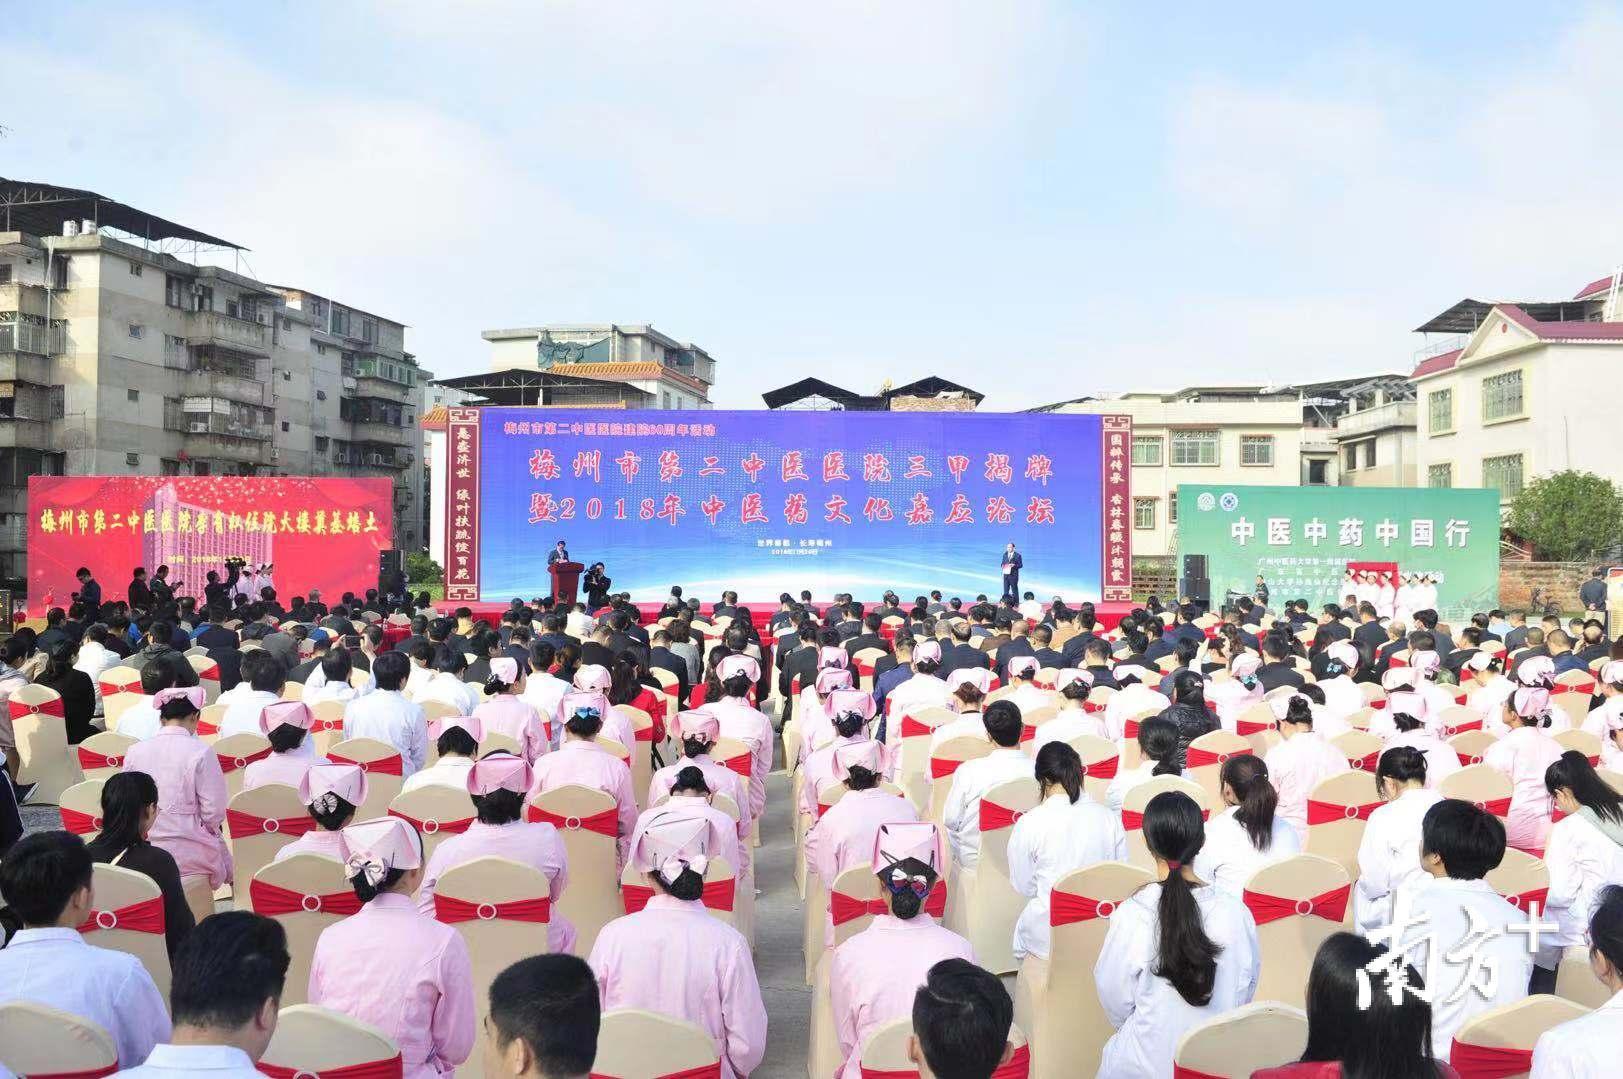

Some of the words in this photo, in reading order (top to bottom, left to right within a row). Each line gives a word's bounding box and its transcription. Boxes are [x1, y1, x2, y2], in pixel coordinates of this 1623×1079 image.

[528, 449, 1054, 485] 梅州市第二中医医院三甲揭牌
[528, 492, 1055, 526] 暨2018年中医药文化嘉应论坛
[1230, 516, 1471, 547] 中医中药中国行
